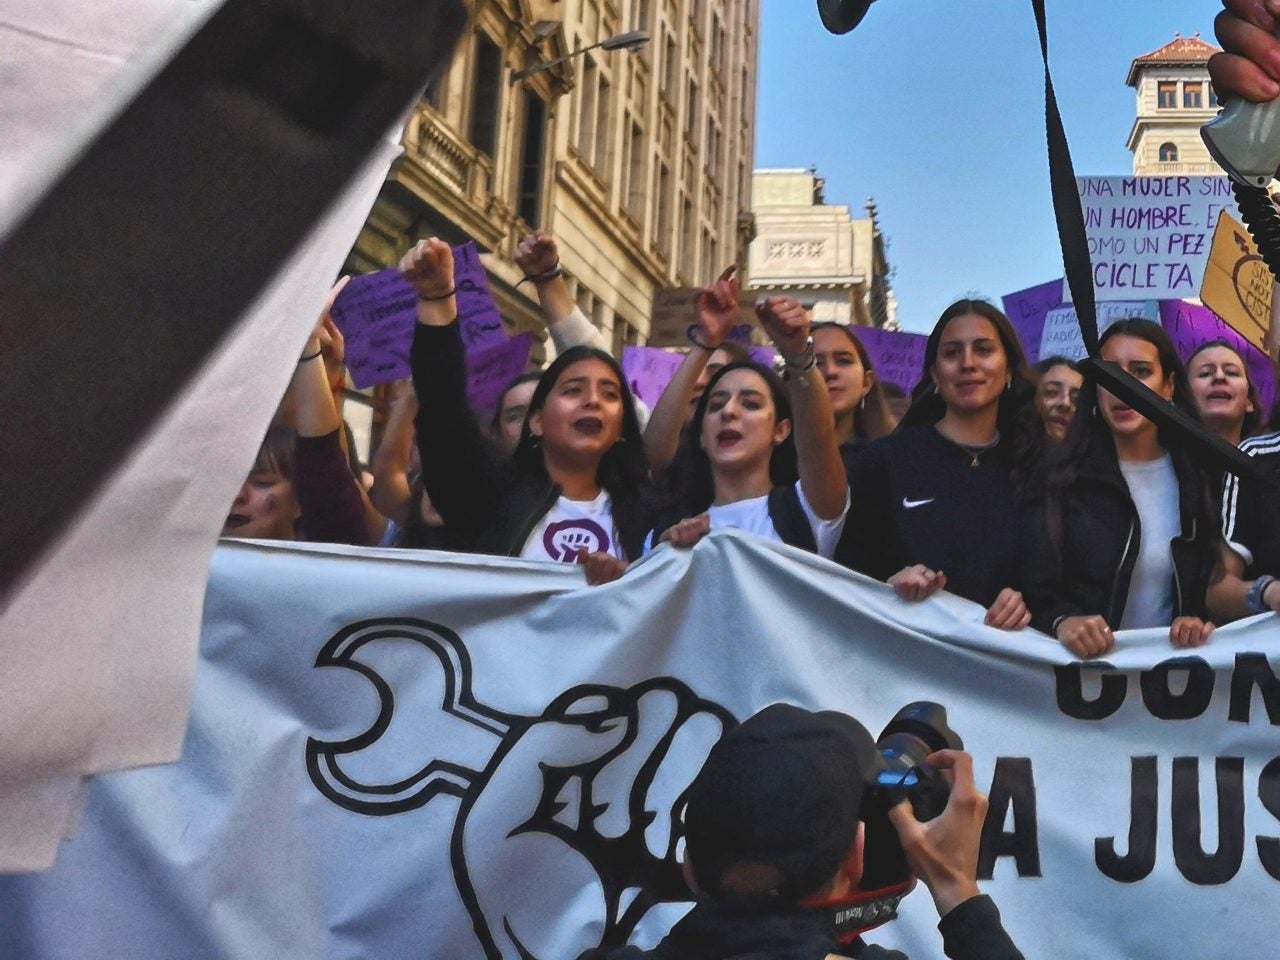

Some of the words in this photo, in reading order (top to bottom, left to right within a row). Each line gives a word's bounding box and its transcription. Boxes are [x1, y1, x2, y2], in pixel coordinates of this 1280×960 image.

[1122, 176, 1191, 197] MUJER
[1199, 176, 1231, 196] SIN
[1087, 236, 1125, 257] OMO
[1133, 236, 1159, 255] UN
[1168, 233, 1205, 256] PEZ
[1094, 259, 1194, 290] CICLETA
